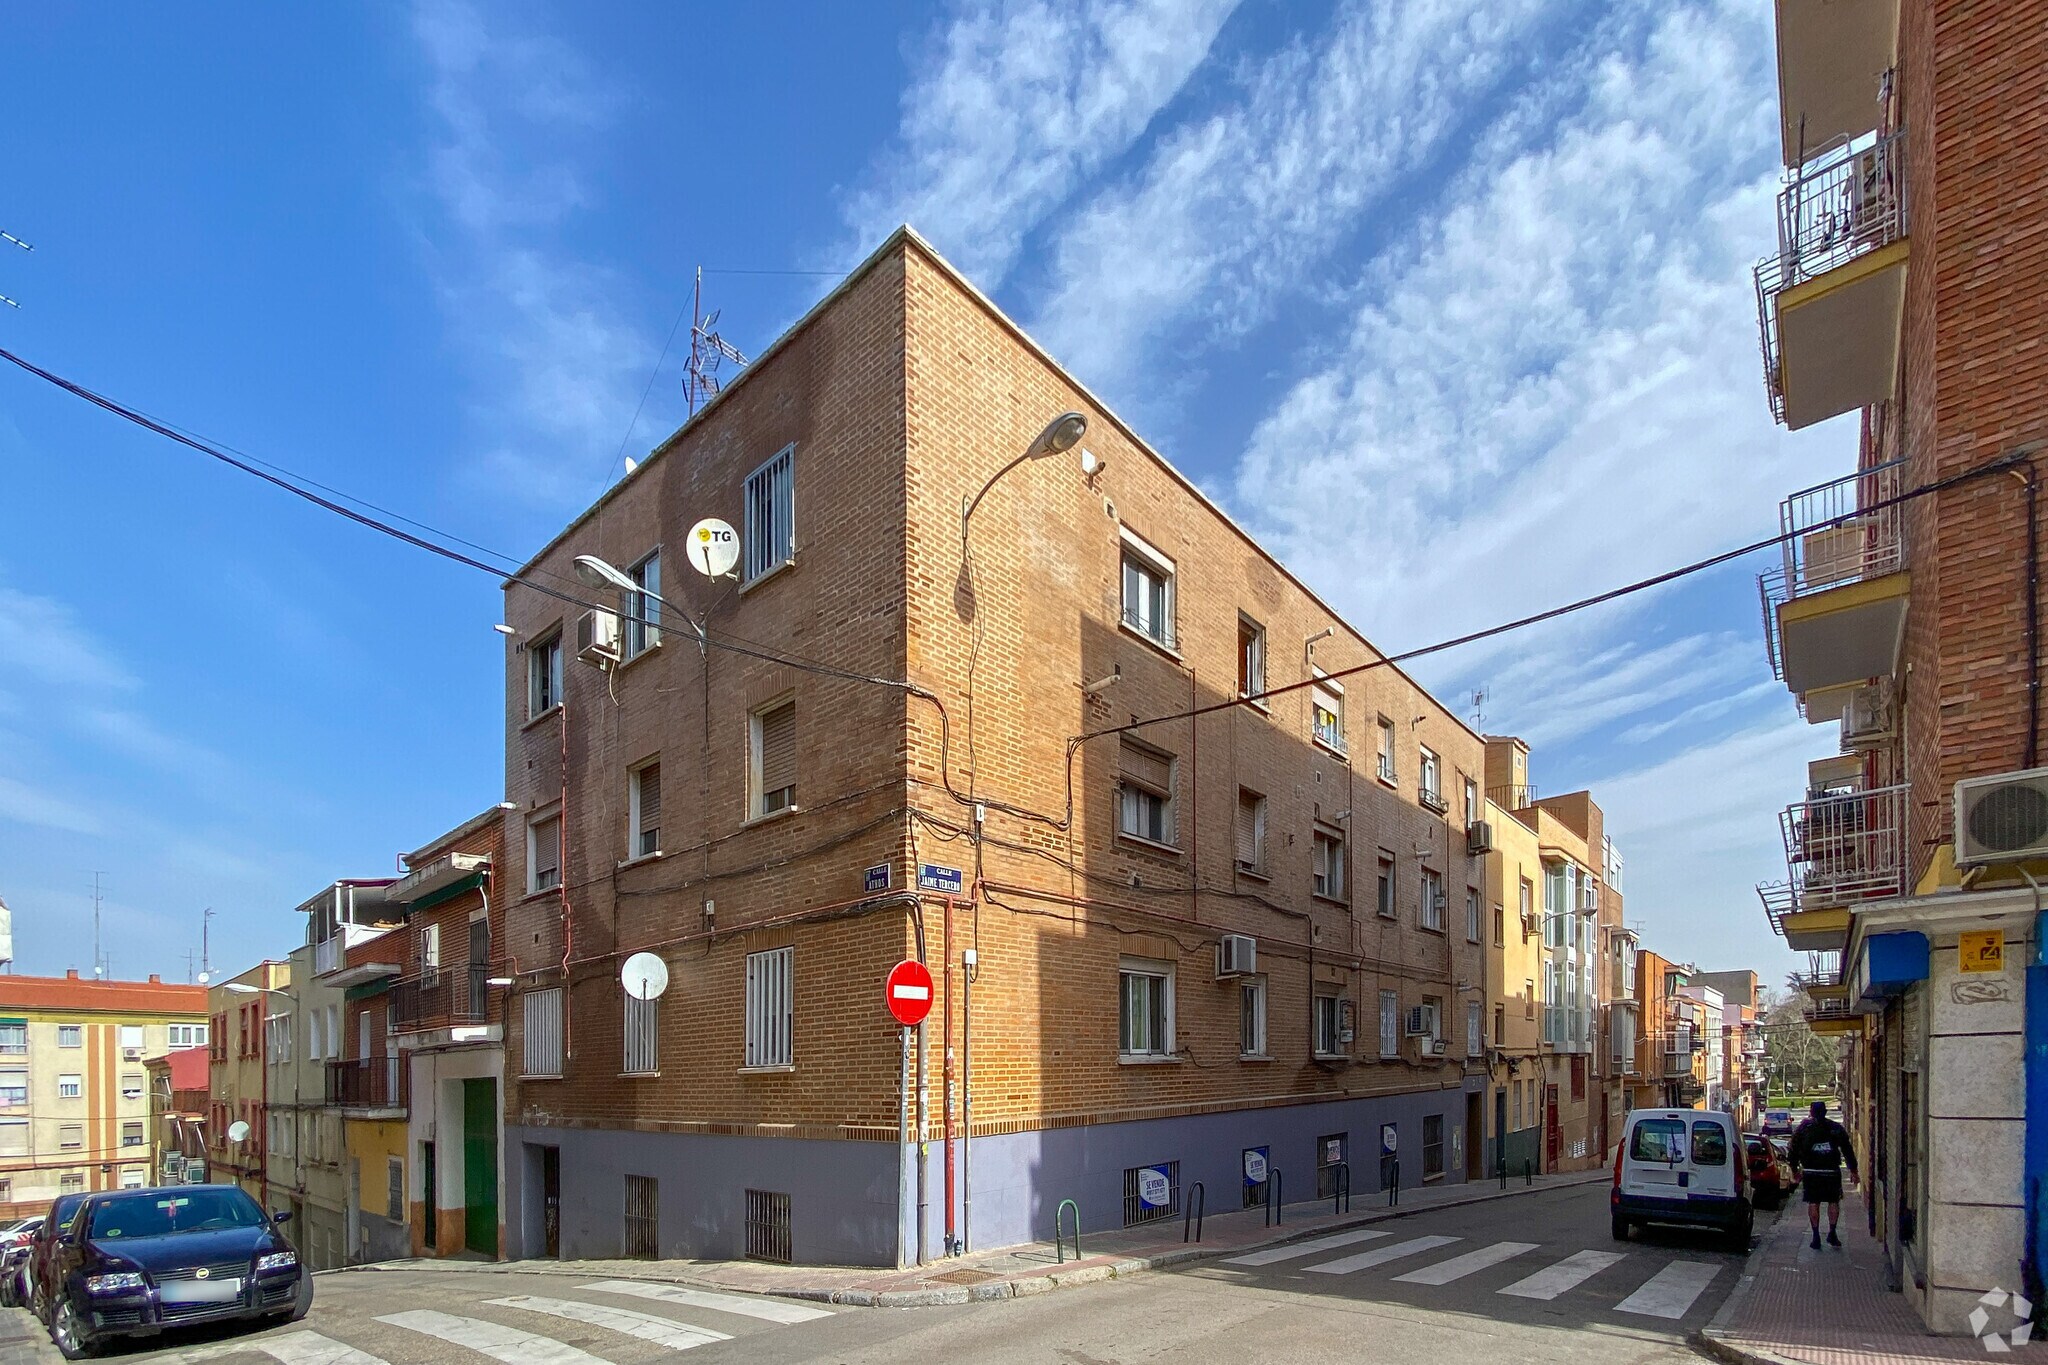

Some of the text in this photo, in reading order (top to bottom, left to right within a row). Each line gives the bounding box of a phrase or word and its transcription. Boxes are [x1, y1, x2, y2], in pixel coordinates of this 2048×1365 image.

[712, 531, 731, 542] TG
[872, 866, 887, 875] CALLE
[936, 867, 953, 877] CALLE
[921, 876, 960, 892] JAIME TERCERO
[1146, 1178, 1165, 1189] SE VENDE
